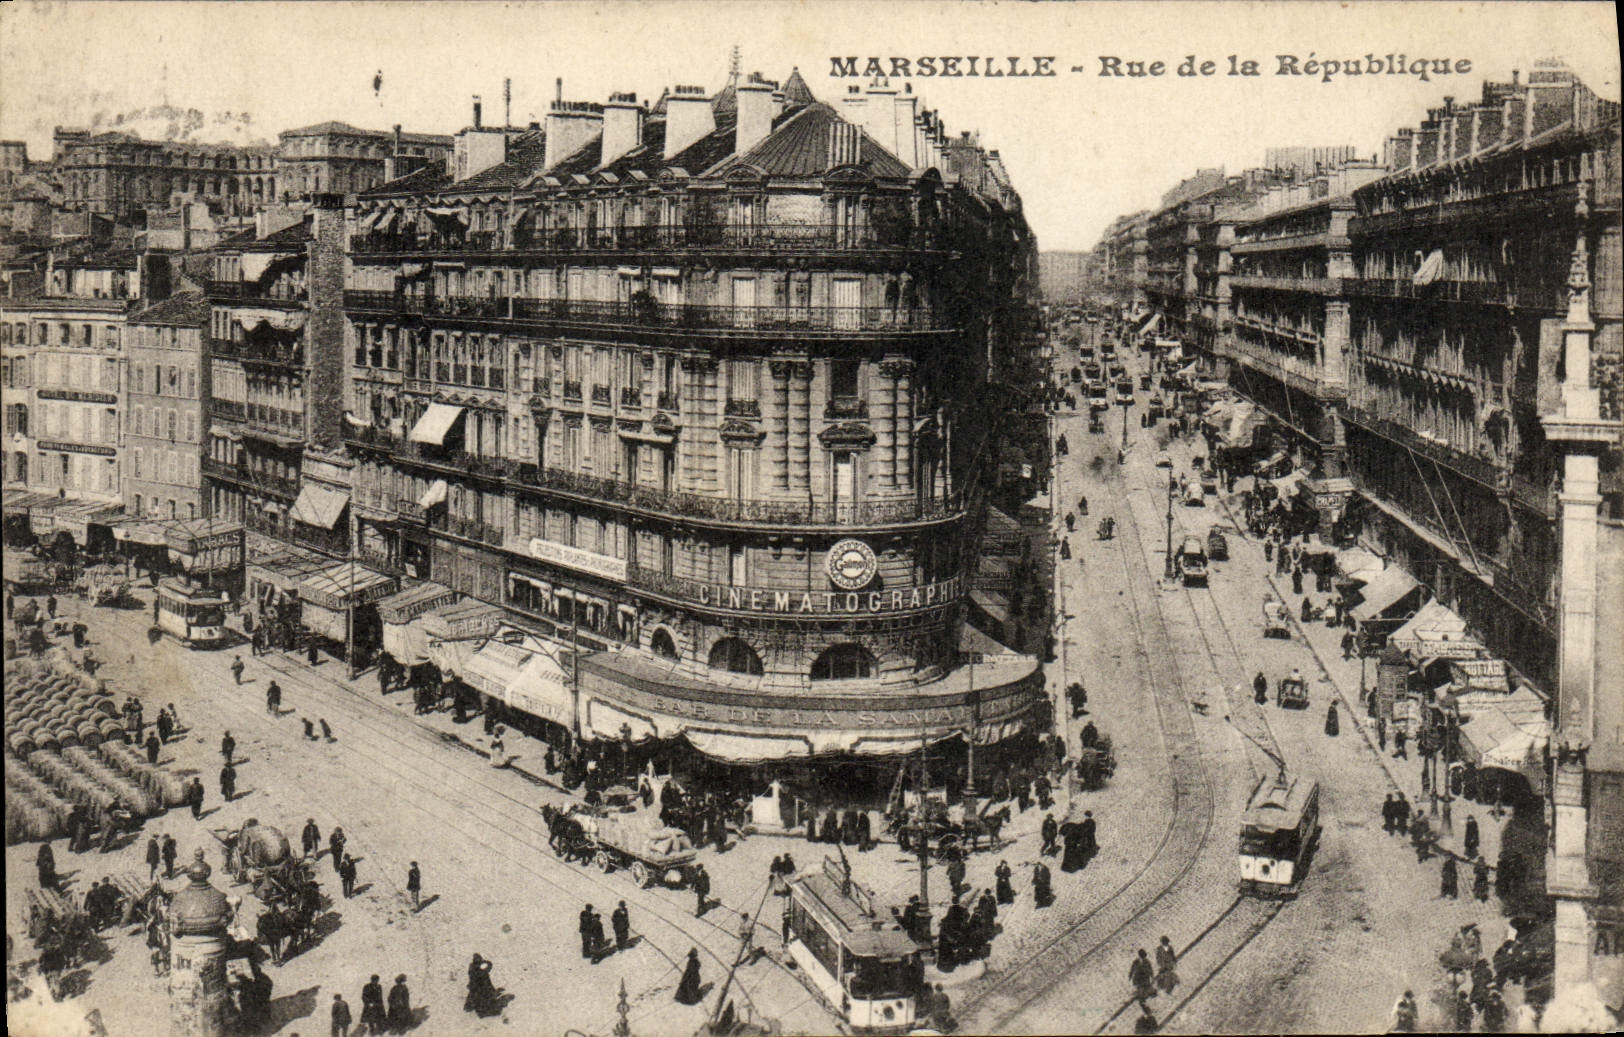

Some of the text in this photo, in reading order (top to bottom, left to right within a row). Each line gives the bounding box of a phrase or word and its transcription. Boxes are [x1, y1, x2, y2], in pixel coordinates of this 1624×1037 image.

[654, 698, 711, 721] BAR
[728, 708, 771, 724] DE
[793, 710, 839, 726] LA
